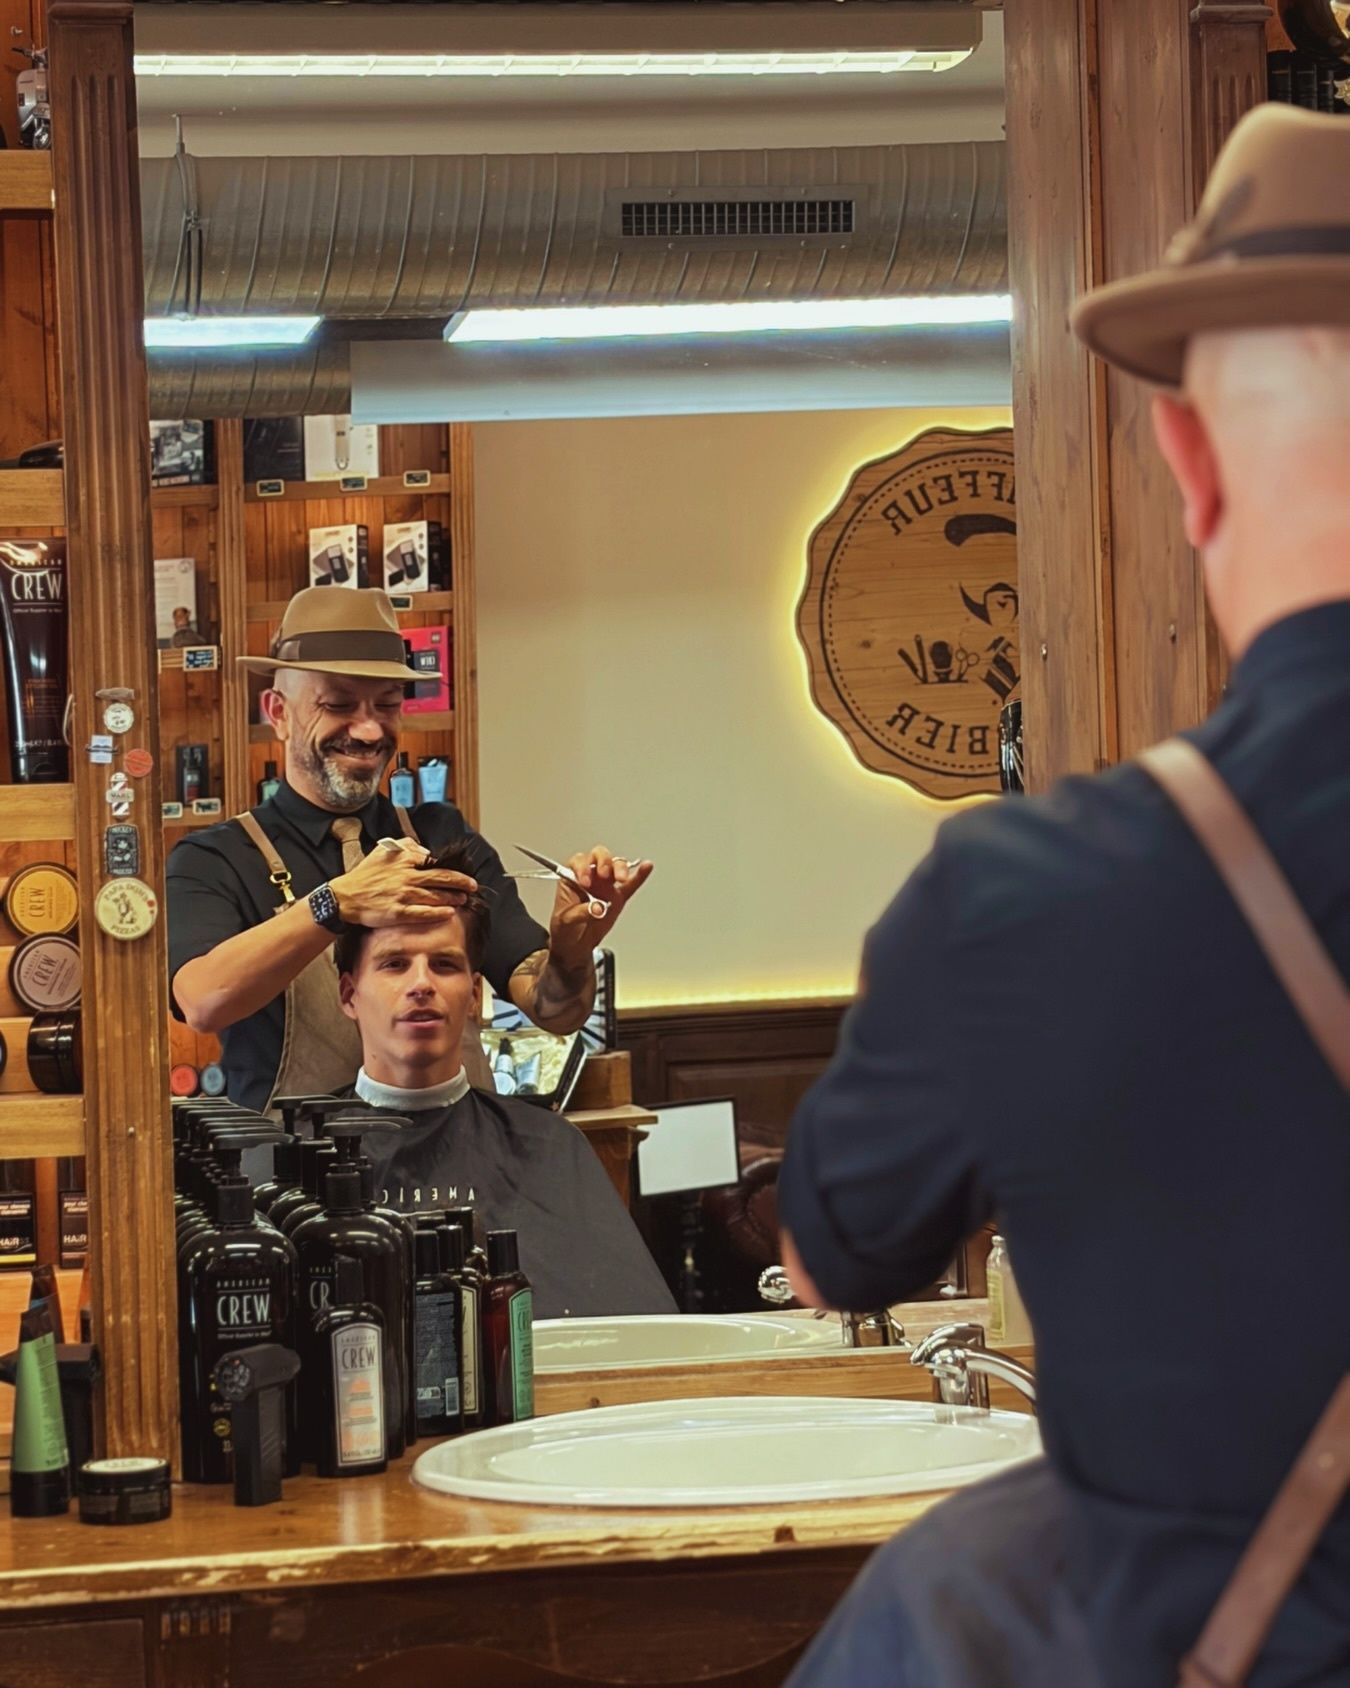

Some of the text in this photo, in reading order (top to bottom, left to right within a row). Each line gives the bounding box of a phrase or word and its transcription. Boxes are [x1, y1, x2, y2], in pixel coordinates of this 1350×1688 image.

[11, 572, 63, 601] CREW
[28, 887, 45, 918] CREW
[31, 954, 58, 987] CREW
[217, 1293, 270, 1326] CREW
[341, 1346, 376, 1370] CREW
